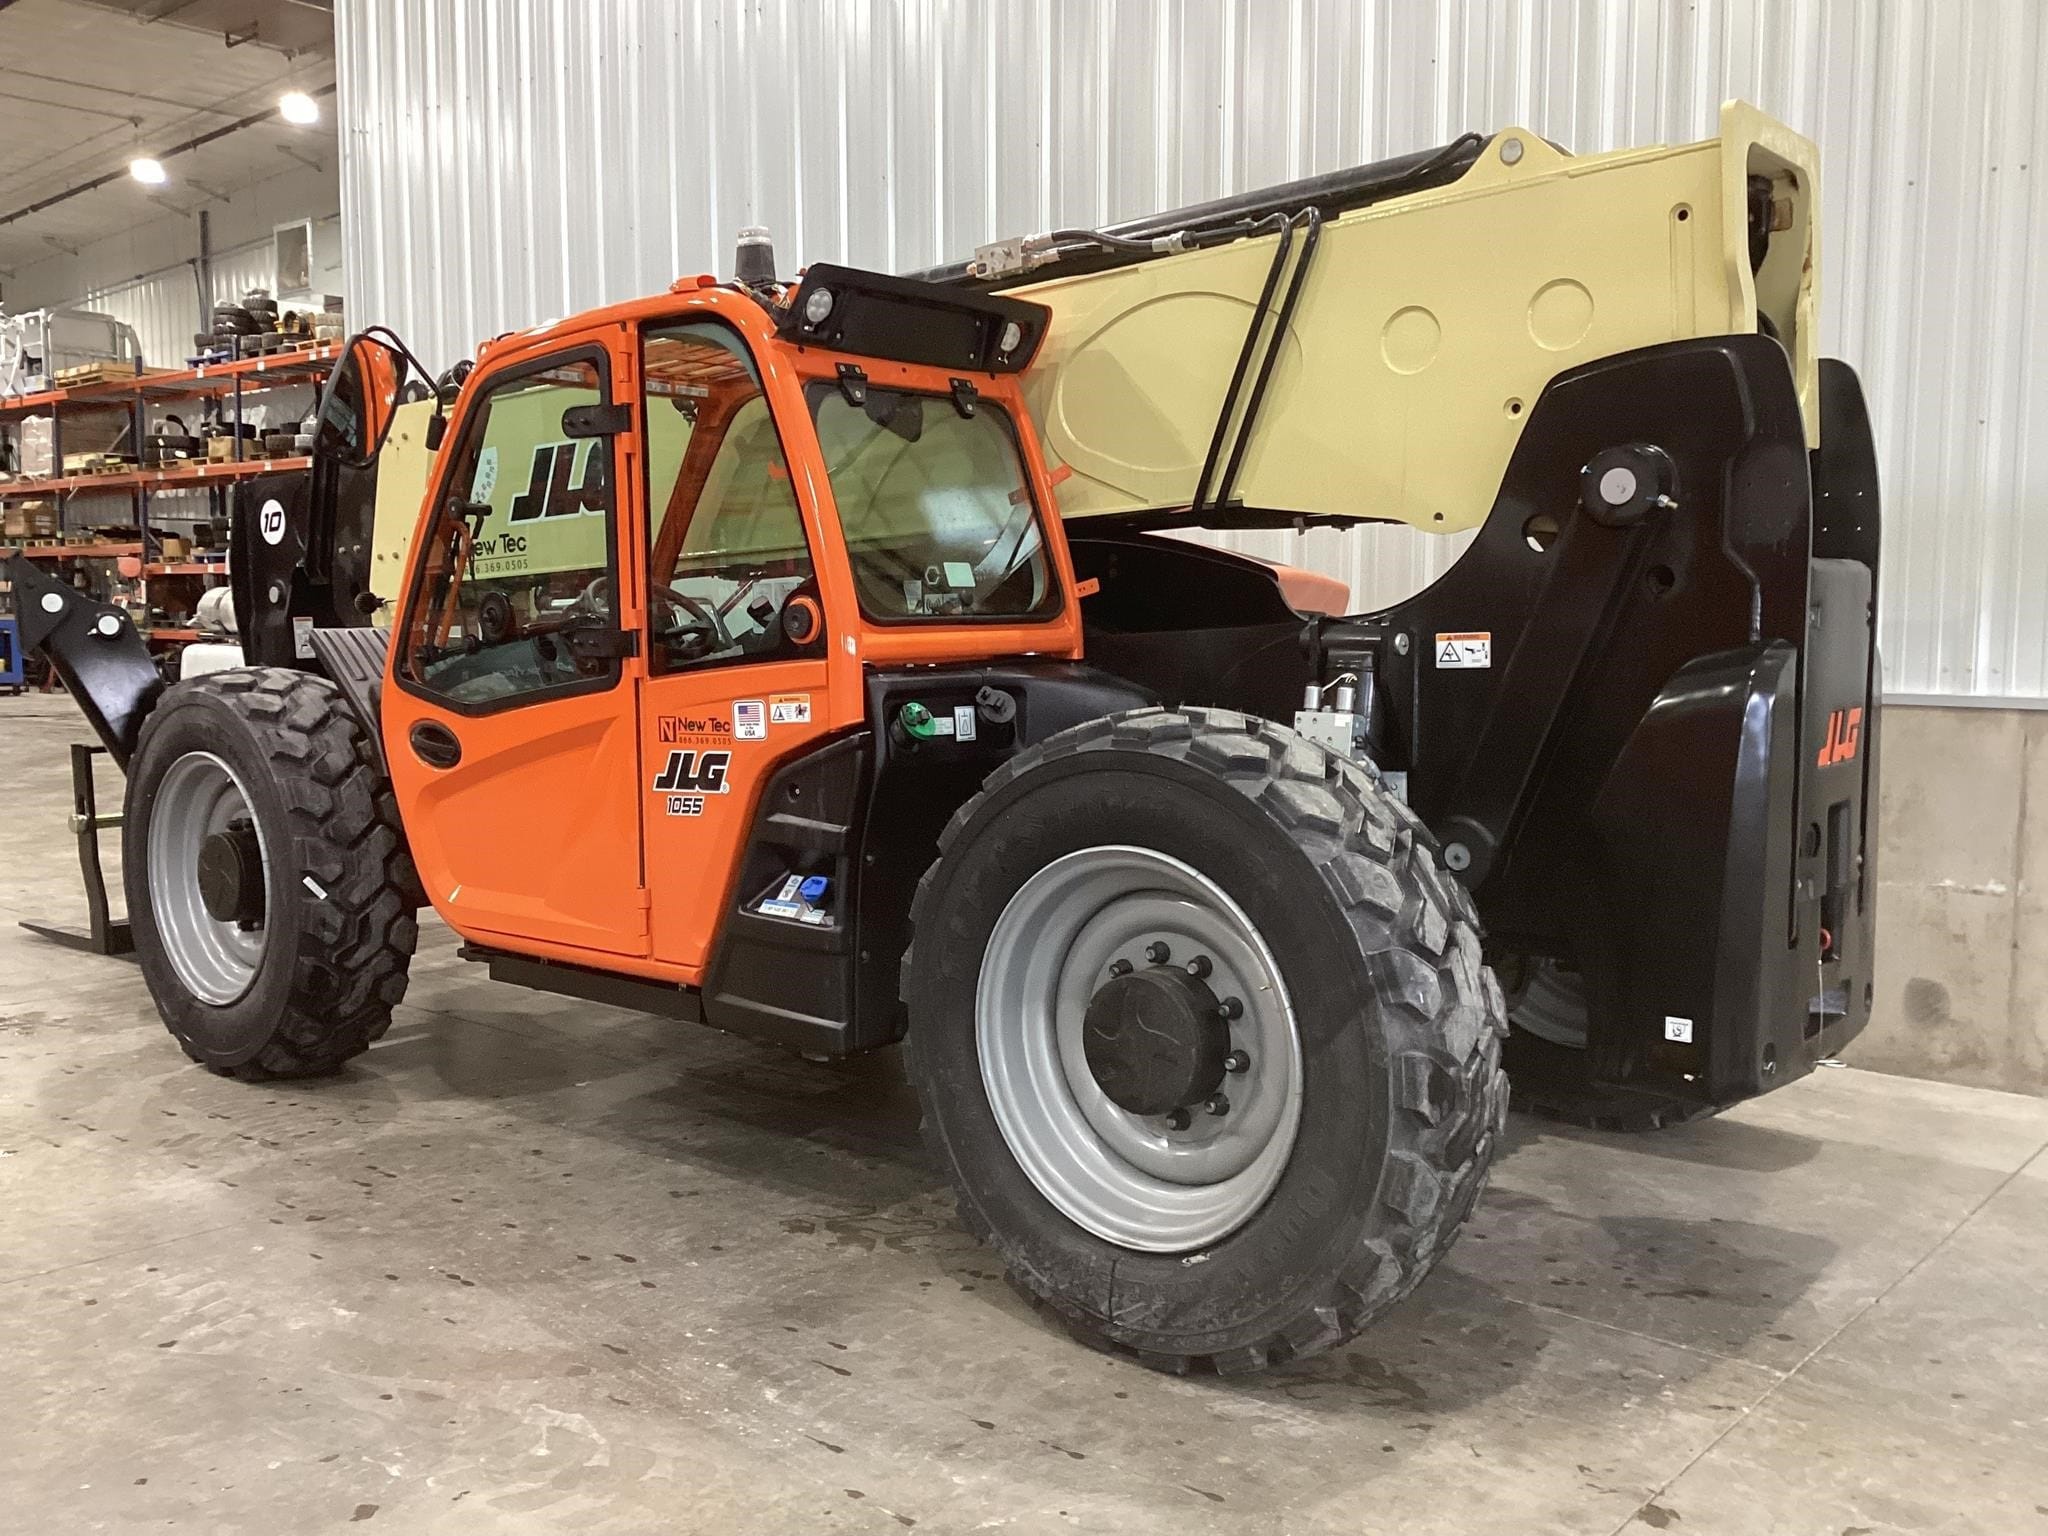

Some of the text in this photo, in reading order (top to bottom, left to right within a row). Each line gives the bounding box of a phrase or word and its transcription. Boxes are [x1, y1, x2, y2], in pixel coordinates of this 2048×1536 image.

[264, 511, 282, 533] 10
[499, 533, 527, 553] Tec
[678, 717, 730, 732] New Tec
[744, 729, 756, 737] USA
[1817, 707, 1862, 769] JLG
[668, 797, 703, 815] 1055
